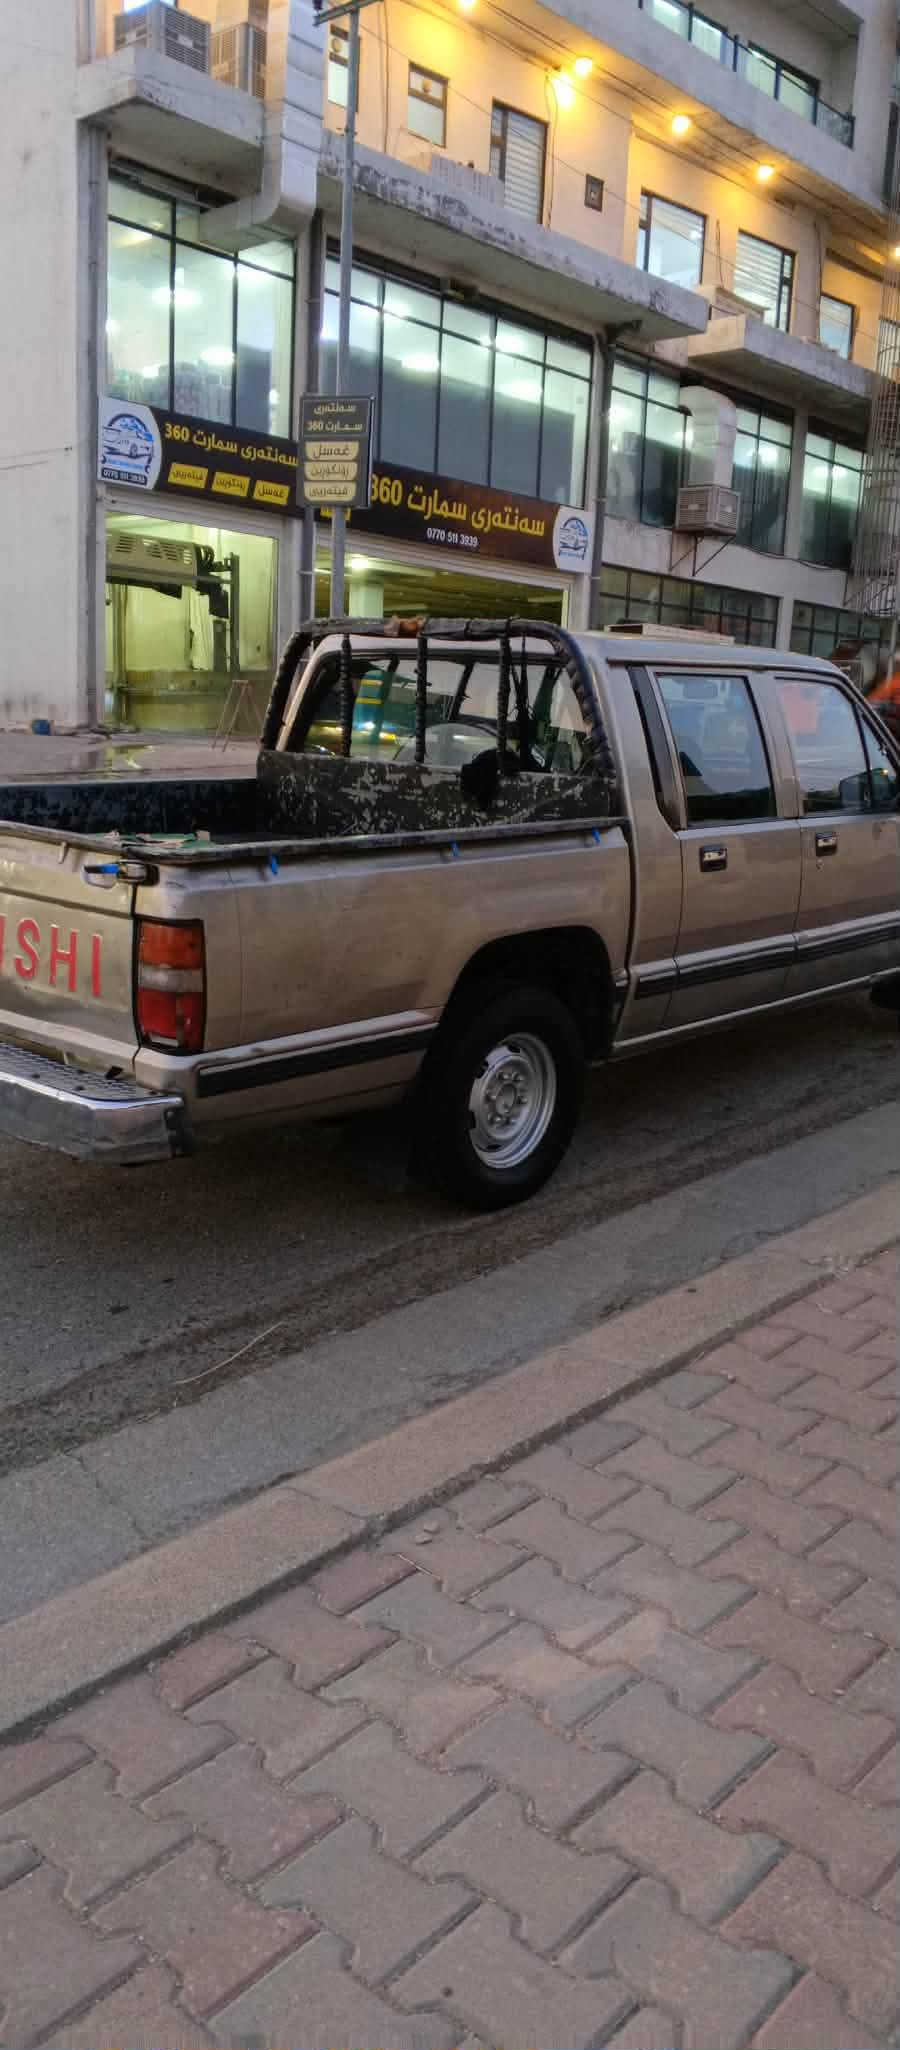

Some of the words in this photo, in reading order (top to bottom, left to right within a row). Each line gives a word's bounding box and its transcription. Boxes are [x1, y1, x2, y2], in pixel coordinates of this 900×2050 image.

[164, 422, 190, 442] 360
[192, 430, 238, 453] سمارت
[407, 485, 467, 521] سمارت
[427, 527, 446, 542] 0770
[447, 532, 459, 544] 511
[460, 534, 478, 547] 3939
[0, 914, 103, 998] SHI
